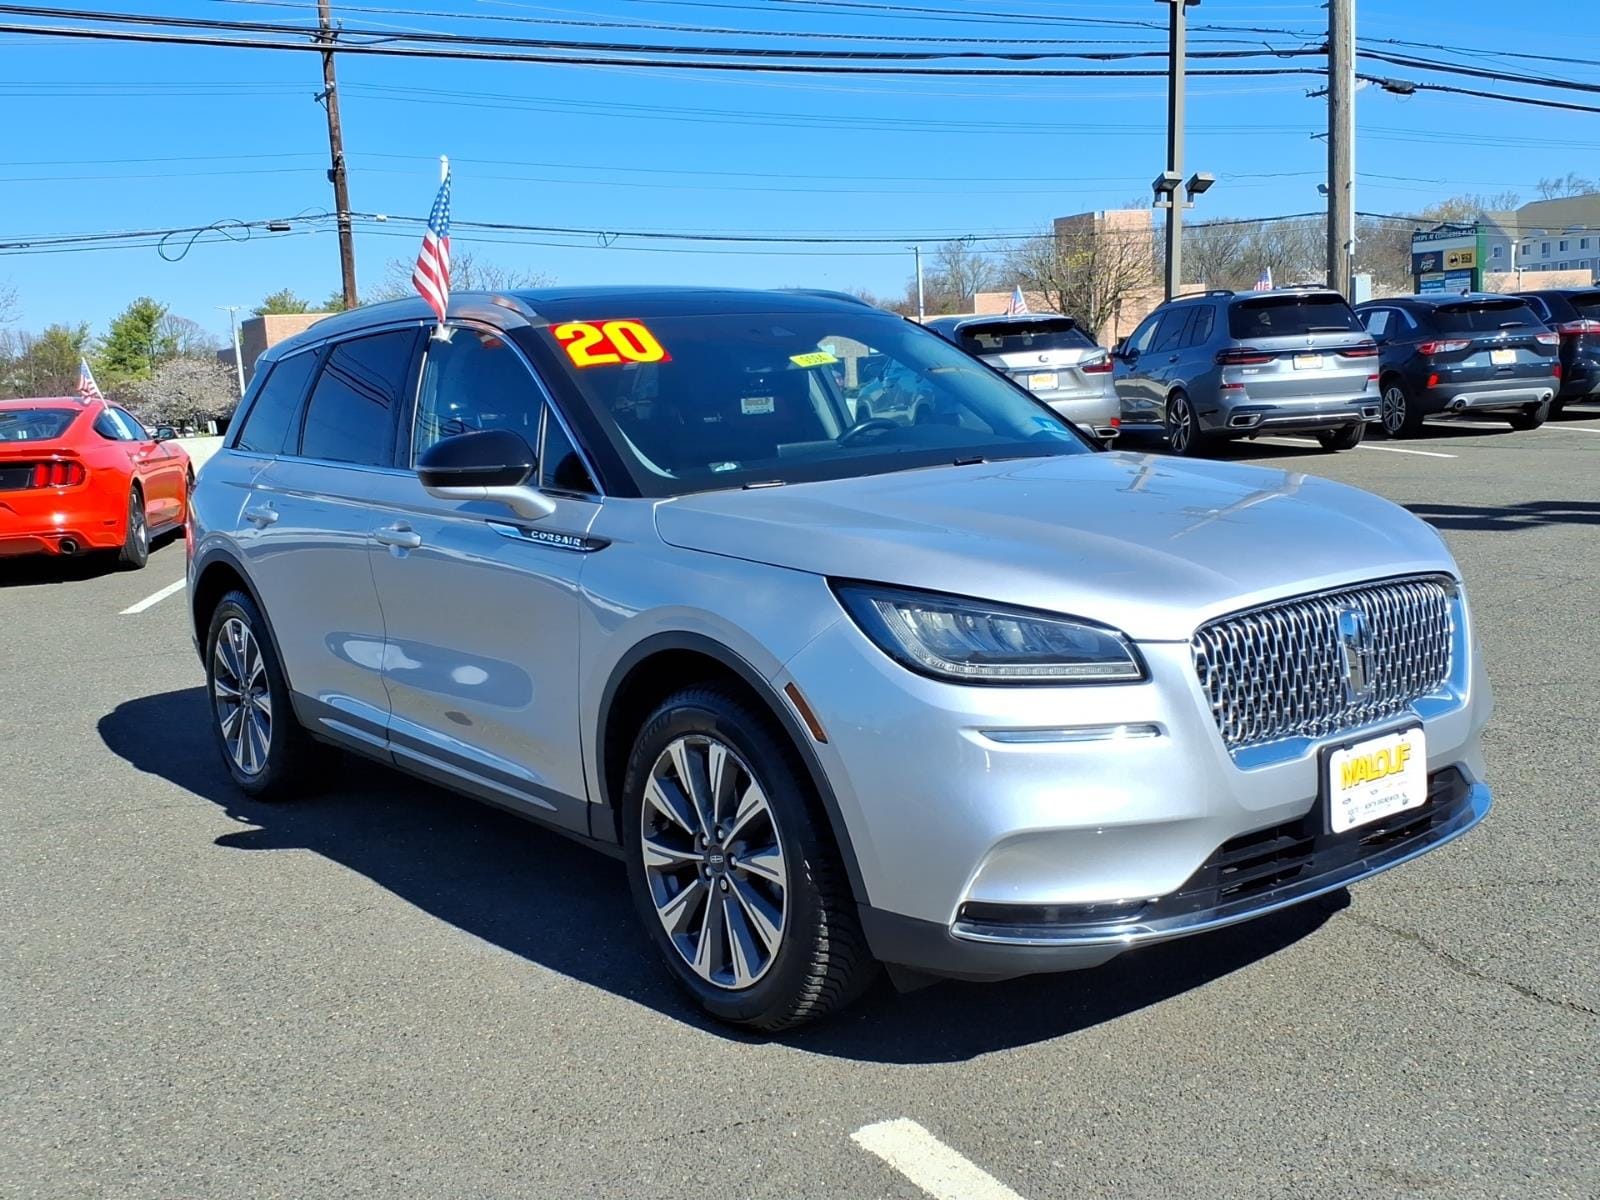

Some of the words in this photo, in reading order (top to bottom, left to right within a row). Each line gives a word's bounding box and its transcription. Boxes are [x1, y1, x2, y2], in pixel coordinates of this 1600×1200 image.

[554, 320, 665, 367] 20
[531, 530, 581, 547] CORSAIR
[1341, 743, 1411, 791] MALOUF
